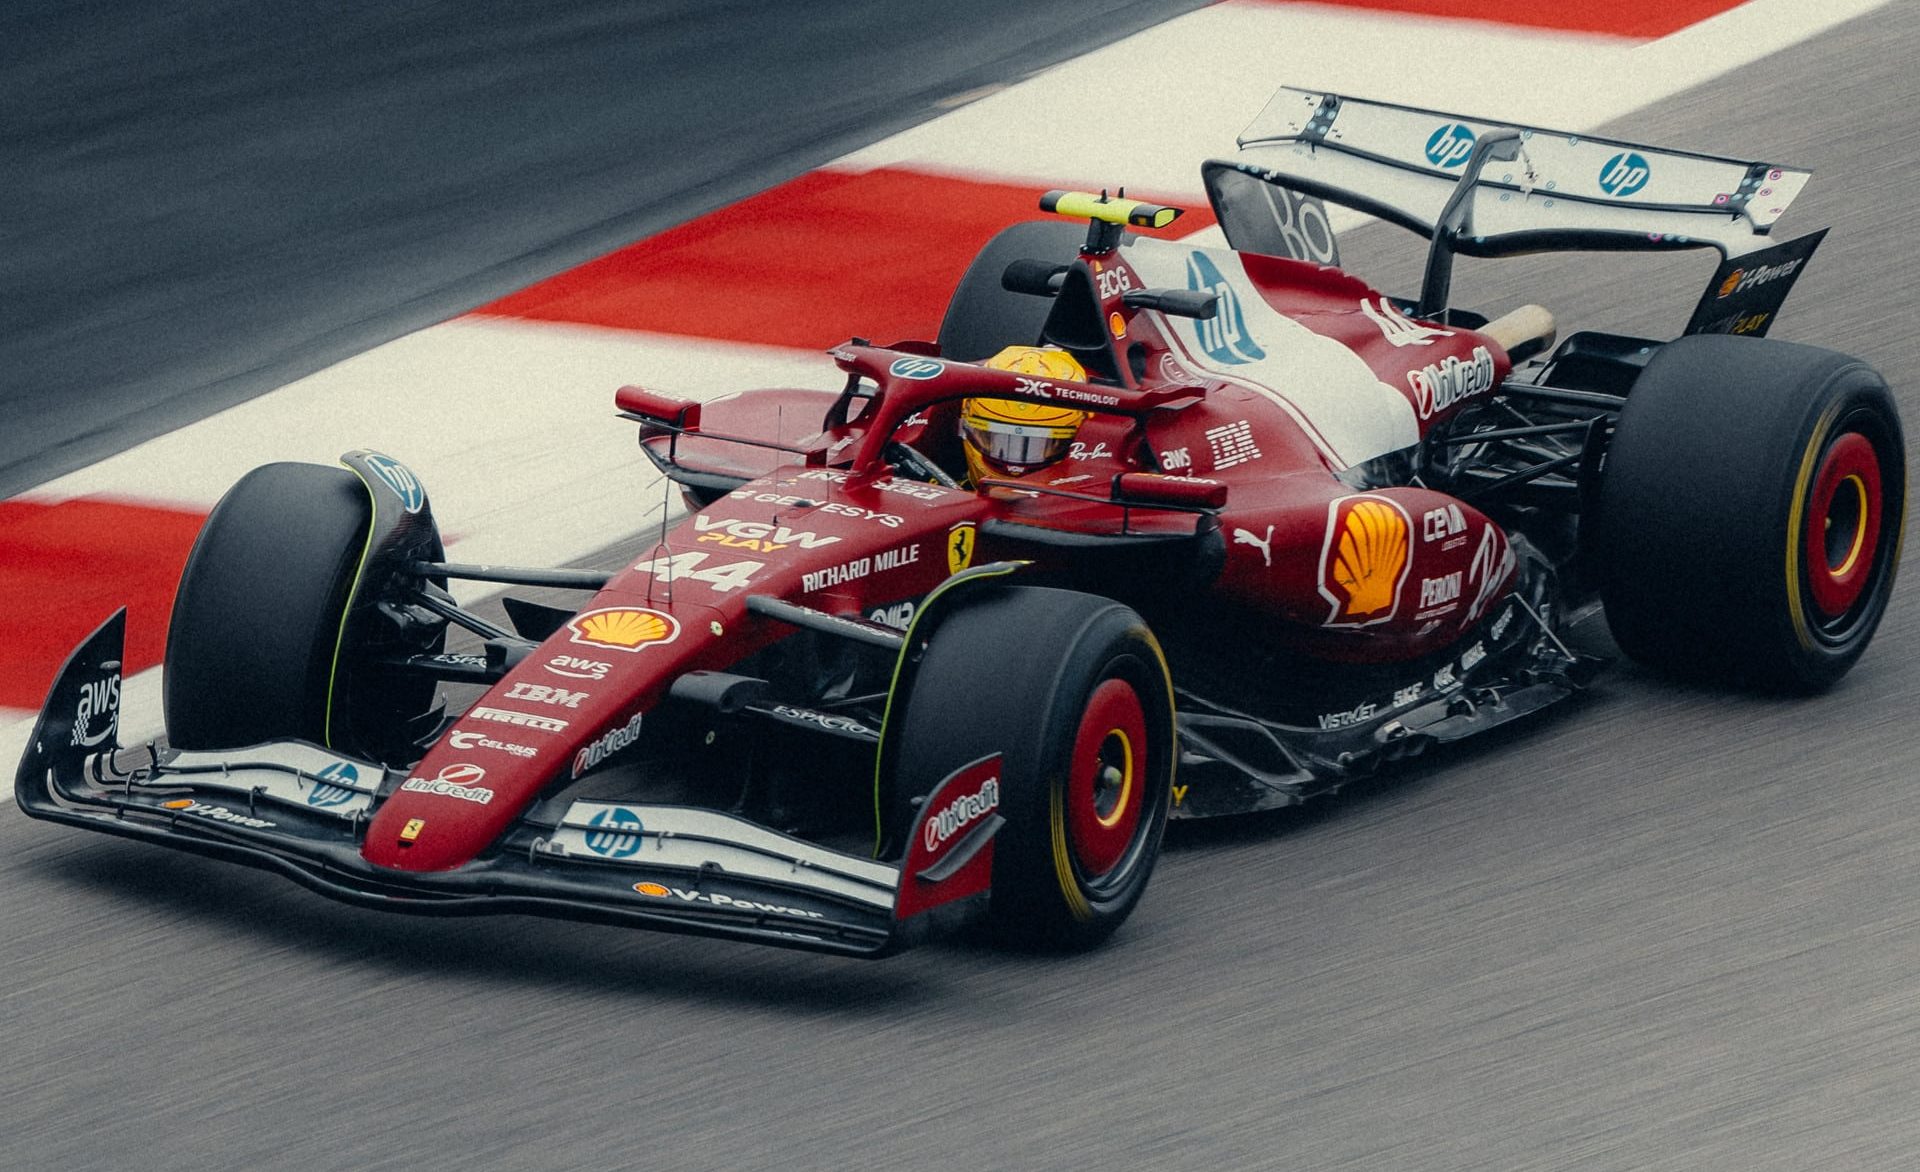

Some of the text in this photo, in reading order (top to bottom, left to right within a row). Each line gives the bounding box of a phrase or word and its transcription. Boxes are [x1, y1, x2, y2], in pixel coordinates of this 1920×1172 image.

[1429, 124, 1475, 168] hp
[1601, 152, 1649, 197] hp
[894, 358, 940, 378] hp
[1015, 377, 1120, 406] DXC TECHNOLOGY
[1069, 442, 1113, 461] Ray-Ban
[1160, 447, 1191, 471] aws
[1205, 420, 1262, 471] IBM
[366, 454, 417, 512] hp
[753, 492, 905, 528] GENESYS
[1423, 503, 1468, 542] CEVA
[694, 515, 841, 550] VGW
[697, 532, 788, 552] PLAY
[634, 551, 766, 592] 44
[802, 543, 920, 594] RICHARD MILLE
[550, 655, 613, 674] aws
[77, 674, 120, 720] aws
[503, 682, 590, 709] IBM
[478, 738, 538, 757] CELSIUS
[400, 777, 495, 805] UniCredit
[671, 887, 825, 918] V-Power
